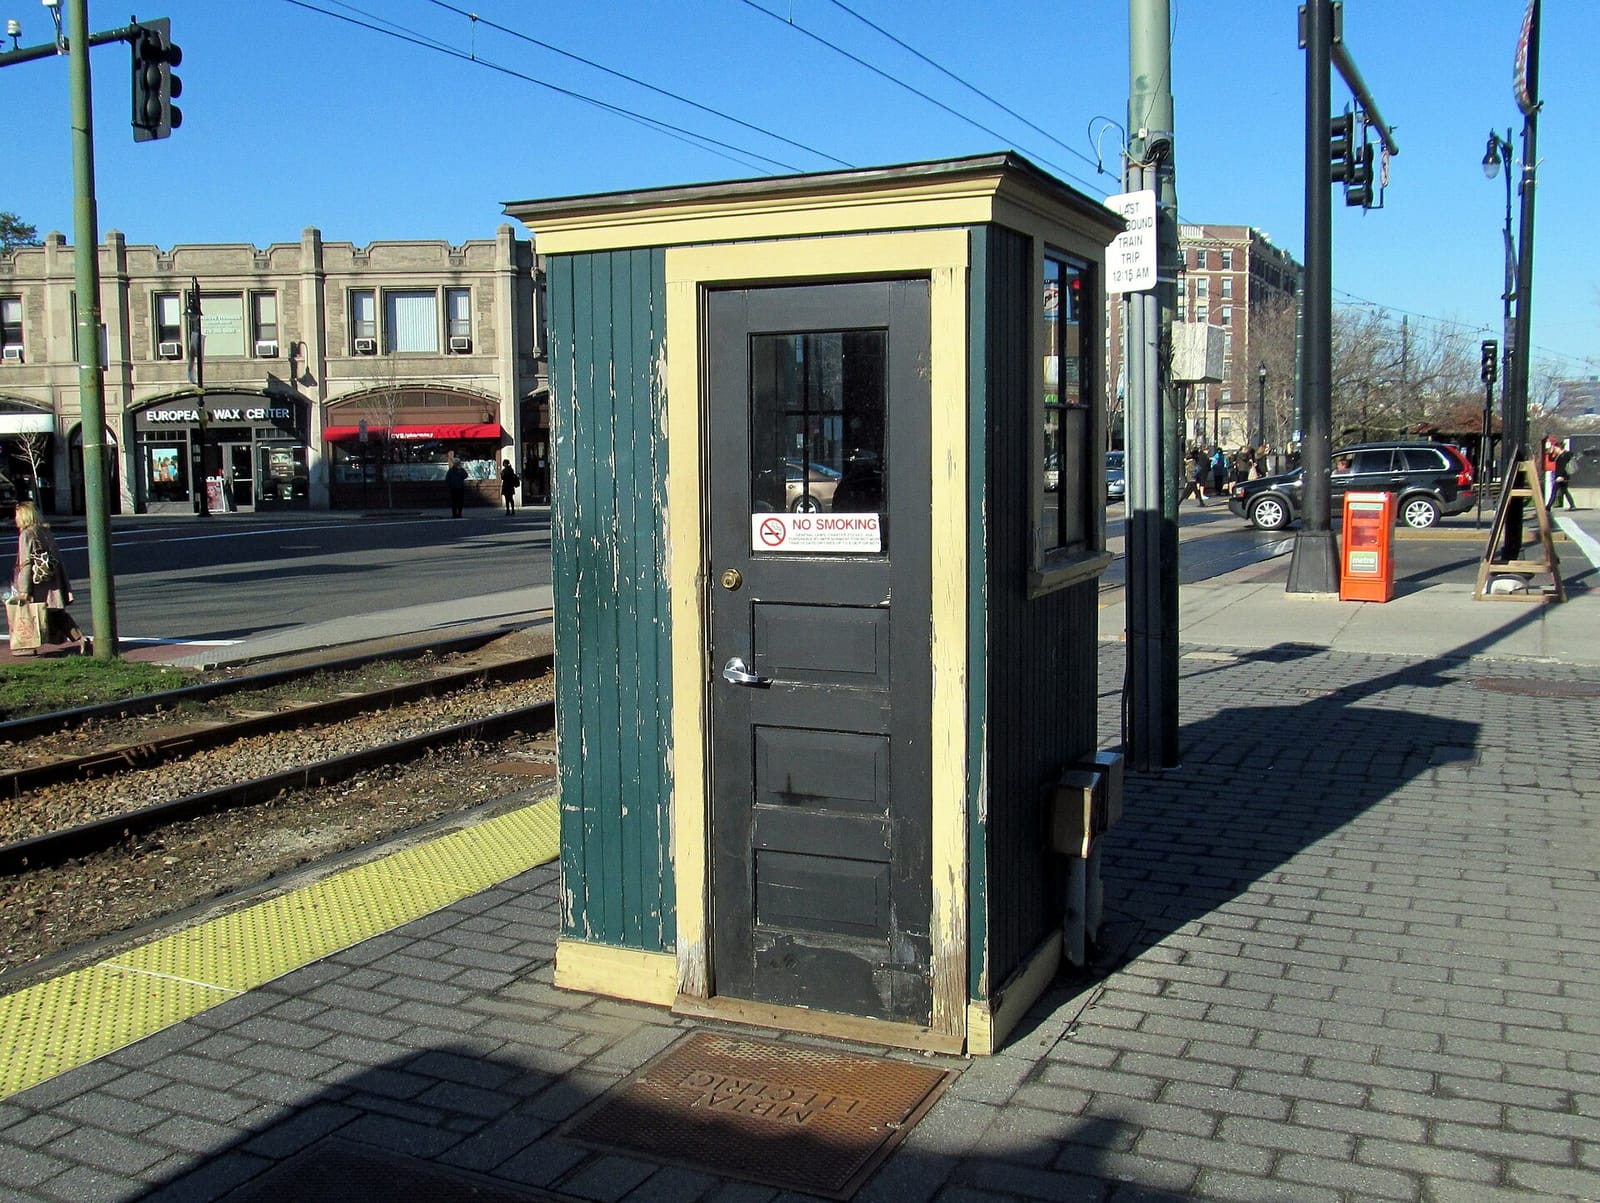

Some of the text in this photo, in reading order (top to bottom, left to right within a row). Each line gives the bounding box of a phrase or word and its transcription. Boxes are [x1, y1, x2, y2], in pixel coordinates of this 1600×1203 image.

[1125, 217, 1153, 231] BOUND
[1118, 235, 1143, 248] TRAIN
[1121, 251, 1140, 265] TRIP
[1113, 267, 1149, 282] 12:15 AM
[146, 408, 289, 421] EUROPEA WAX CENTER
[792, 518, 877, 530] NO SMOKING
